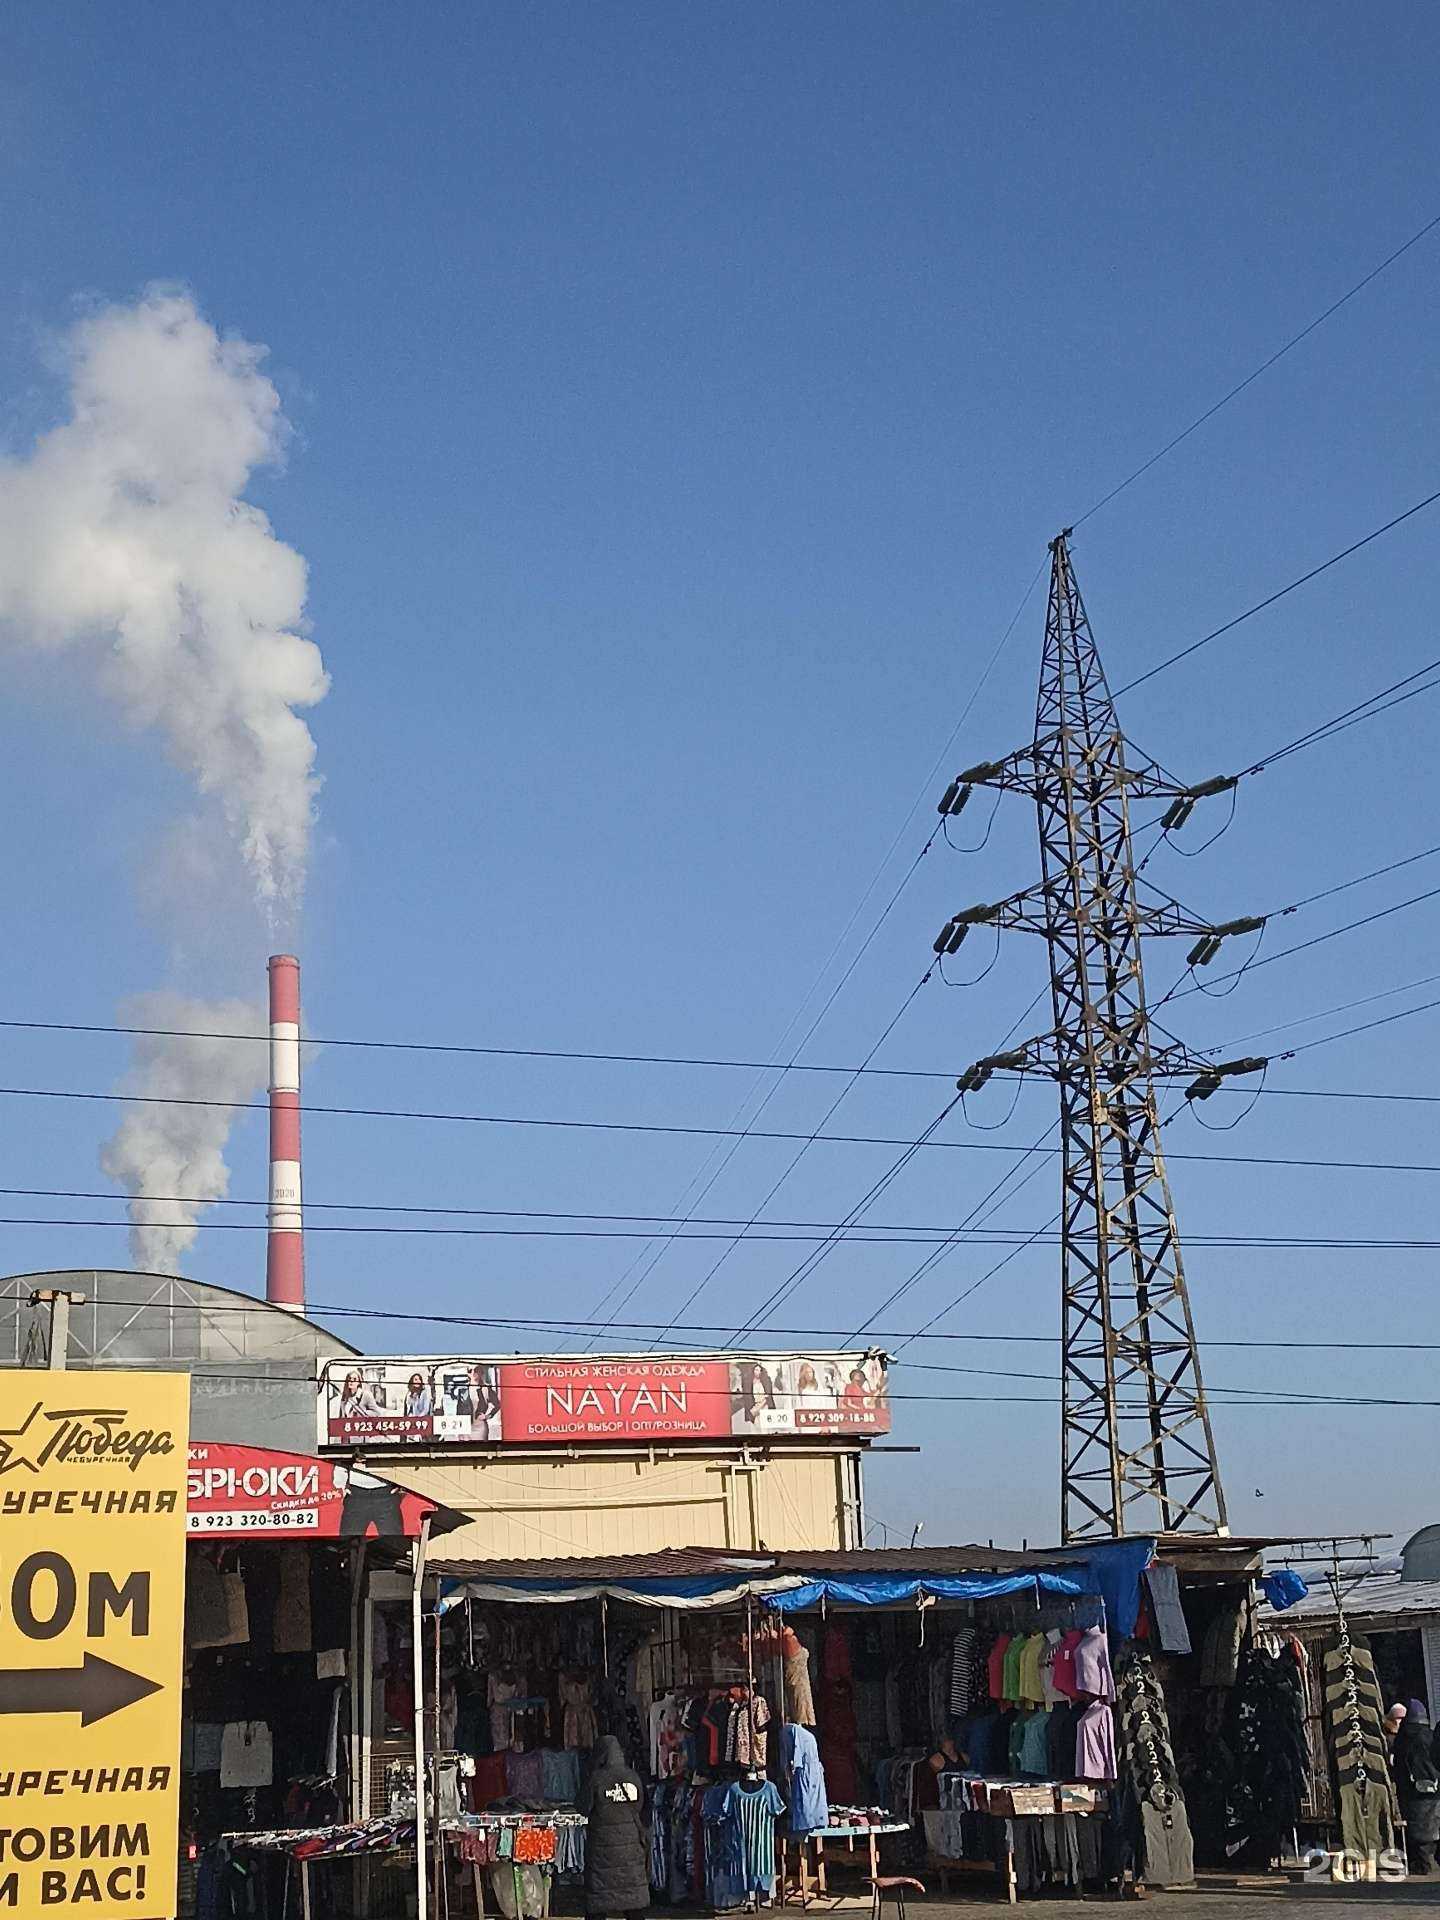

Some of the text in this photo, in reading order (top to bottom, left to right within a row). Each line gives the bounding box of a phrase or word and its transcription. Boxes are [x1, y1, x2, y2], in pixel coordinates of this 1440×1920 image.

[525, 1364, 706, 1379] СТИЛЬНАЯ ЖЕНСКАЯ ОДЕЖДА
[546, 1381, 688, 1417] NAYAN
[354, 1421, 373, 1432] 923
[528, 1422, 585, 1433] БОЛЬШОЙ
[587, 1421, 624, 1432] ВЫБОР
[37, 1409, 175, 1472] Победа
[2, 1490, 178, 1514] УРЕЧНАЯ
[191, 1512, 315, 1528] 8 923 320-80-82
[41, 1865, 146, 1905] ВАС!
